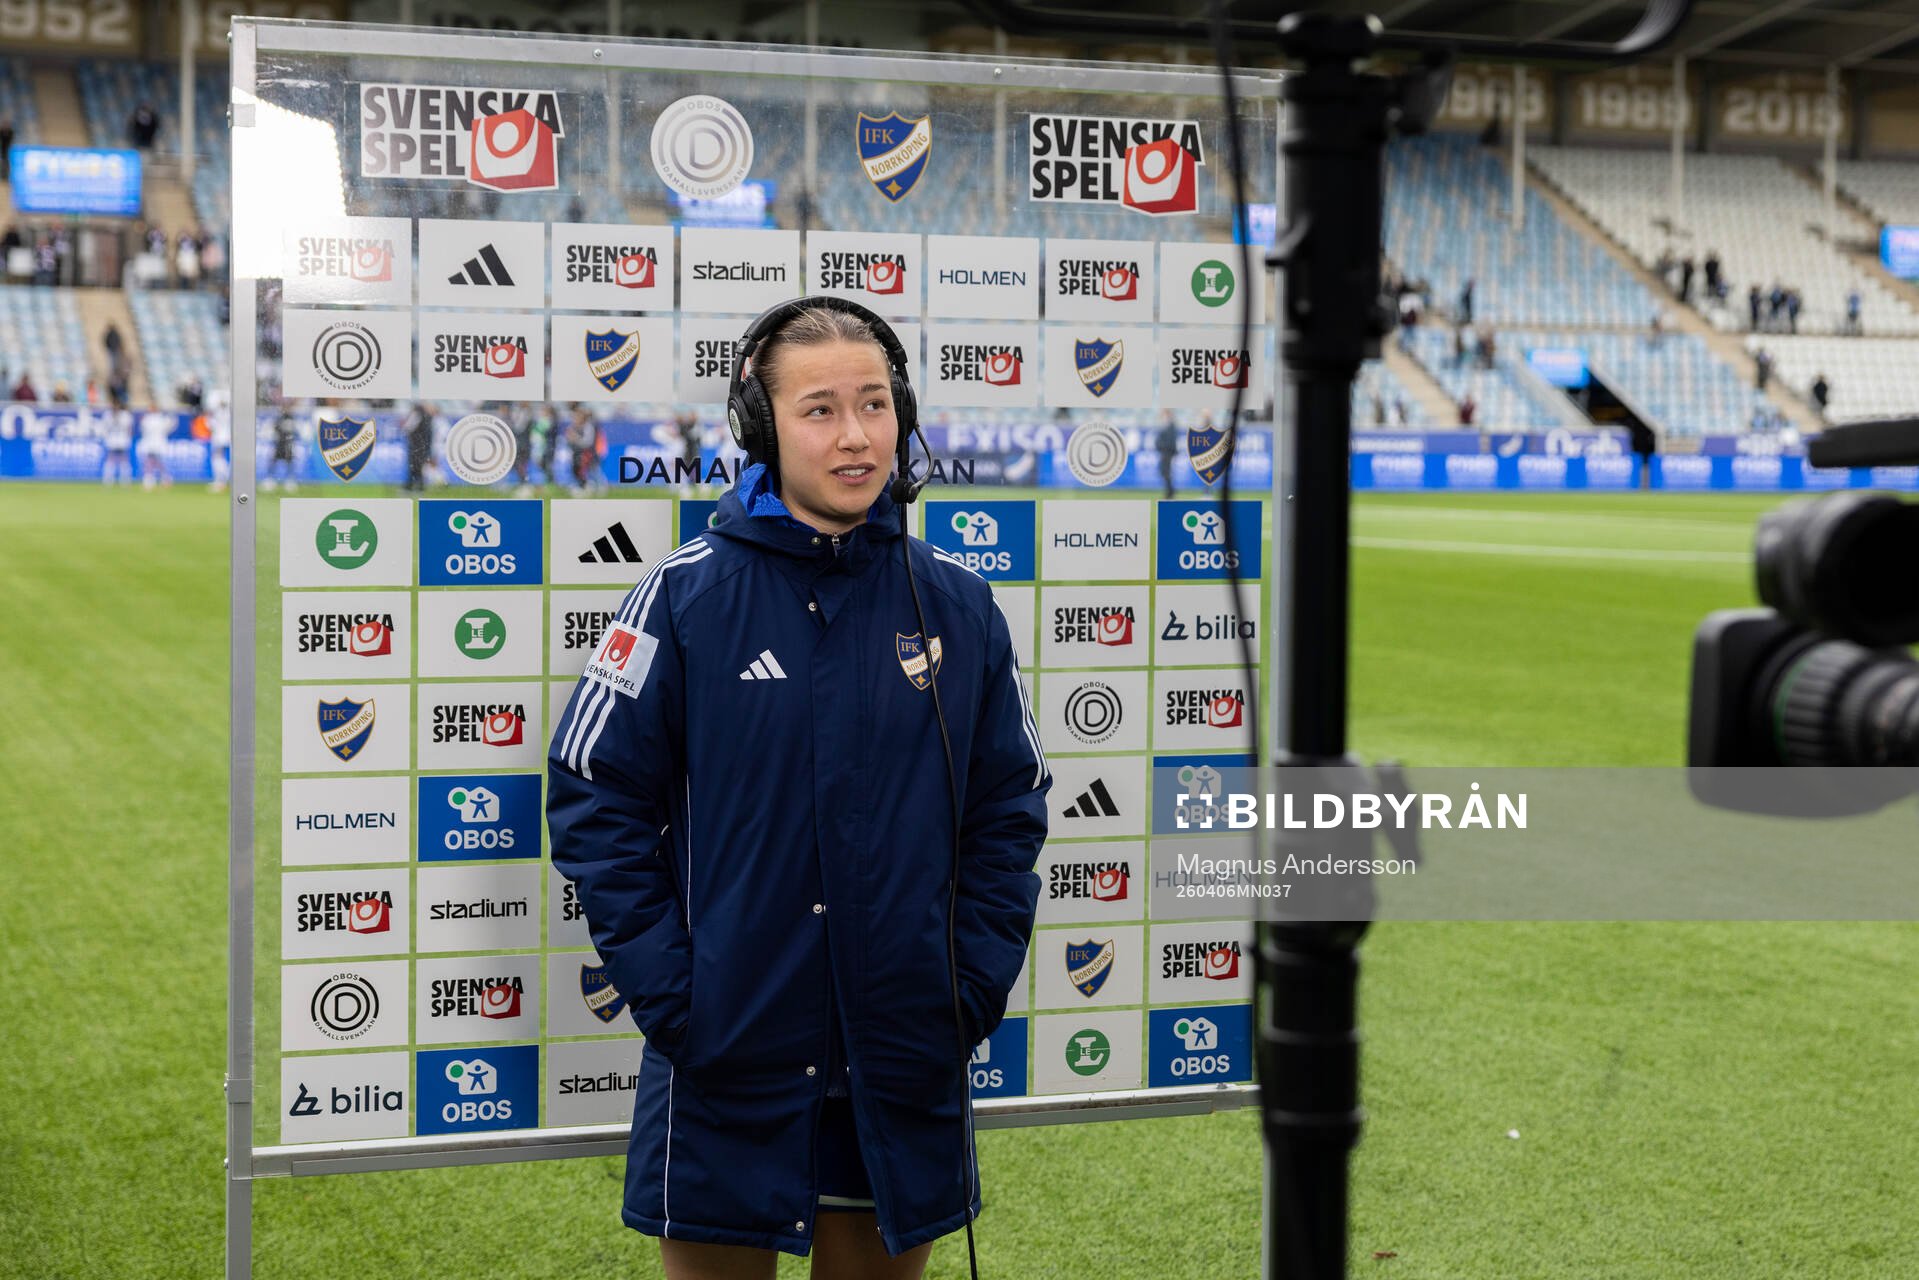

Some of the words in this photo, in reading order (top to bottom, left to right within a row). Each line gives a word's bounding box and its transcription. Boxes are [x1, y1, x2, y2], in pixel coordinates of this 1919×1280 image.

[364, 86, 561, 134] SVENSKA
[687, 100, 722, 113] OBOS
[864, 128, 895, 144] IFK
[1032, 117, 1201, 161] SVENSKA
[364, 131, 465, 175] SPEL
[1032, 159, 1119, 200] SPEL
[298, 237, 395, 258] SVENSKA
[566, 244, 658, 265] SVENSKA
[298, 257, 348, 276] SPEL
[820, 252, 907, 272] SVENSKA
[1059, 259, 1140, 278] SVENSKA
[566, 264, 613, 283] SPEL
[693, 261, 785, 282] stadium
[820, 271, 865, 289] SPEL
[939, 269, 1026, 286] HOLMEN
[1058, 278, 1100, 296] SPEL
[334, 322, 361, 330] OBOS
[434, 334, 528, 354] SVENSKA
[590, 340, 613, 351] IFK
[940, 345, 1024, 363] SVENSKA
[1079, 348, 1099, 359] IFK
[1171, 349, 1251, 367] SVENSKA
[434, 354, 482, 373] SPEL
[695, 359, 732, 377] SPE
[940, 363, 983, 381] SPEL
[1171, 367, 1212, 384] SPEL
[1192, 436, 1210, 447] IFK
[1054, 533, 1138, 547] HOLMEN
[445, 554, 516, 575] OBOS
[1179, 550, 1239, 569] OBOS
[298, 614, 394, 632] SVENSKA
[1054, 606, 1135, 625] SVENSKA
[1054, 625, 1096, 643] SPEL
[1196, 614, 1256, 640] bilia
[298, 634, 347, 652] SPEL
[564, 631, 604, 649] SPE
[901, 642, 920, 652] IFK
[614, 675, 635, 691] SPEL
[1083, 681, 1105, 689] OBOS
[1166, 689, 1245, 707] SVENSKA
[323, 709, 347, 720] IFK
[433, 704, 526, 724] SVENSKA
[1166, 707, 1206, 725] SPEL
[433, 724, 480, 743] SPEL
[296, 812, 395, 830] HOLMEN
[444, 828, 515, 850] OBOS
[1050, 861, 1130, 881] SVENSKA
[1050, 881, 1091, 899] SPEL
[297, 891, 393, 912] SVENSKA
[430, 899, 527, 920] stadium
[297, 912, 347, 932] SPEL
[1070, 951, 1090, 961] IFK
[1162, 941, 1241, 961] SVENSKA
[332, 973, 359, 981] OBOS
[586, 973, 608, 984] IFK
[1162, 961, 1202, 978] SPEL
[431, 976, 524, 998] SVENSKA
[431, 998, 478, 1017] SPEL
[314, 1018, 376, 1041] DAMALLSVENSKAN
[1170, 1054, 1230, 1077] OBOS
[331, 1085, 403, 1114] bilia
[442, 1100, 512, 1123] OBOS
